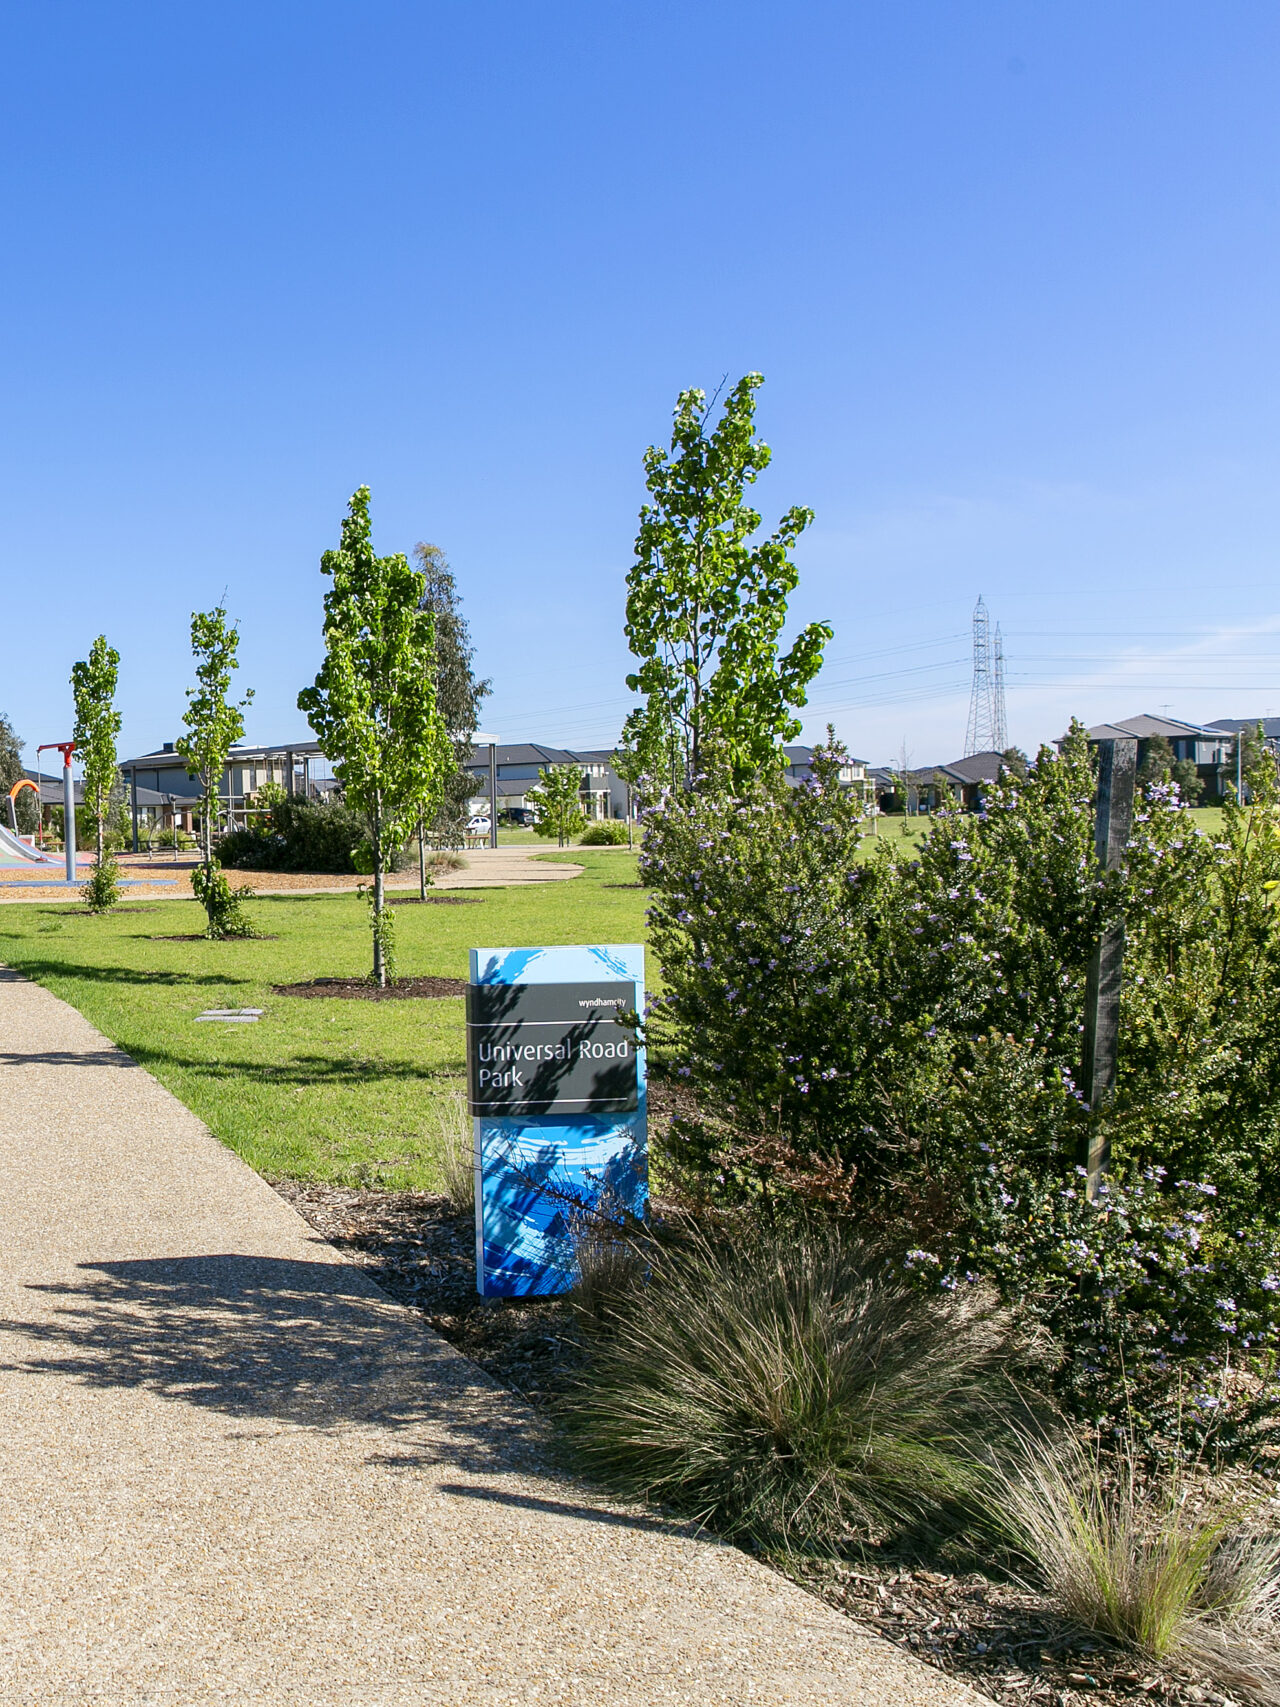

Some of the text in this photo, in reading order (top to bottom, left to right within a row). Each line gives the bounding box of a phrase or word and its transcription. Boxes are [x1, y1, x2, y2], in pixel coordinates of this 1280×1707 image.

[479, 1038, 628, 1062] Universal Road
[479, 1065, 523, 1088] Park
